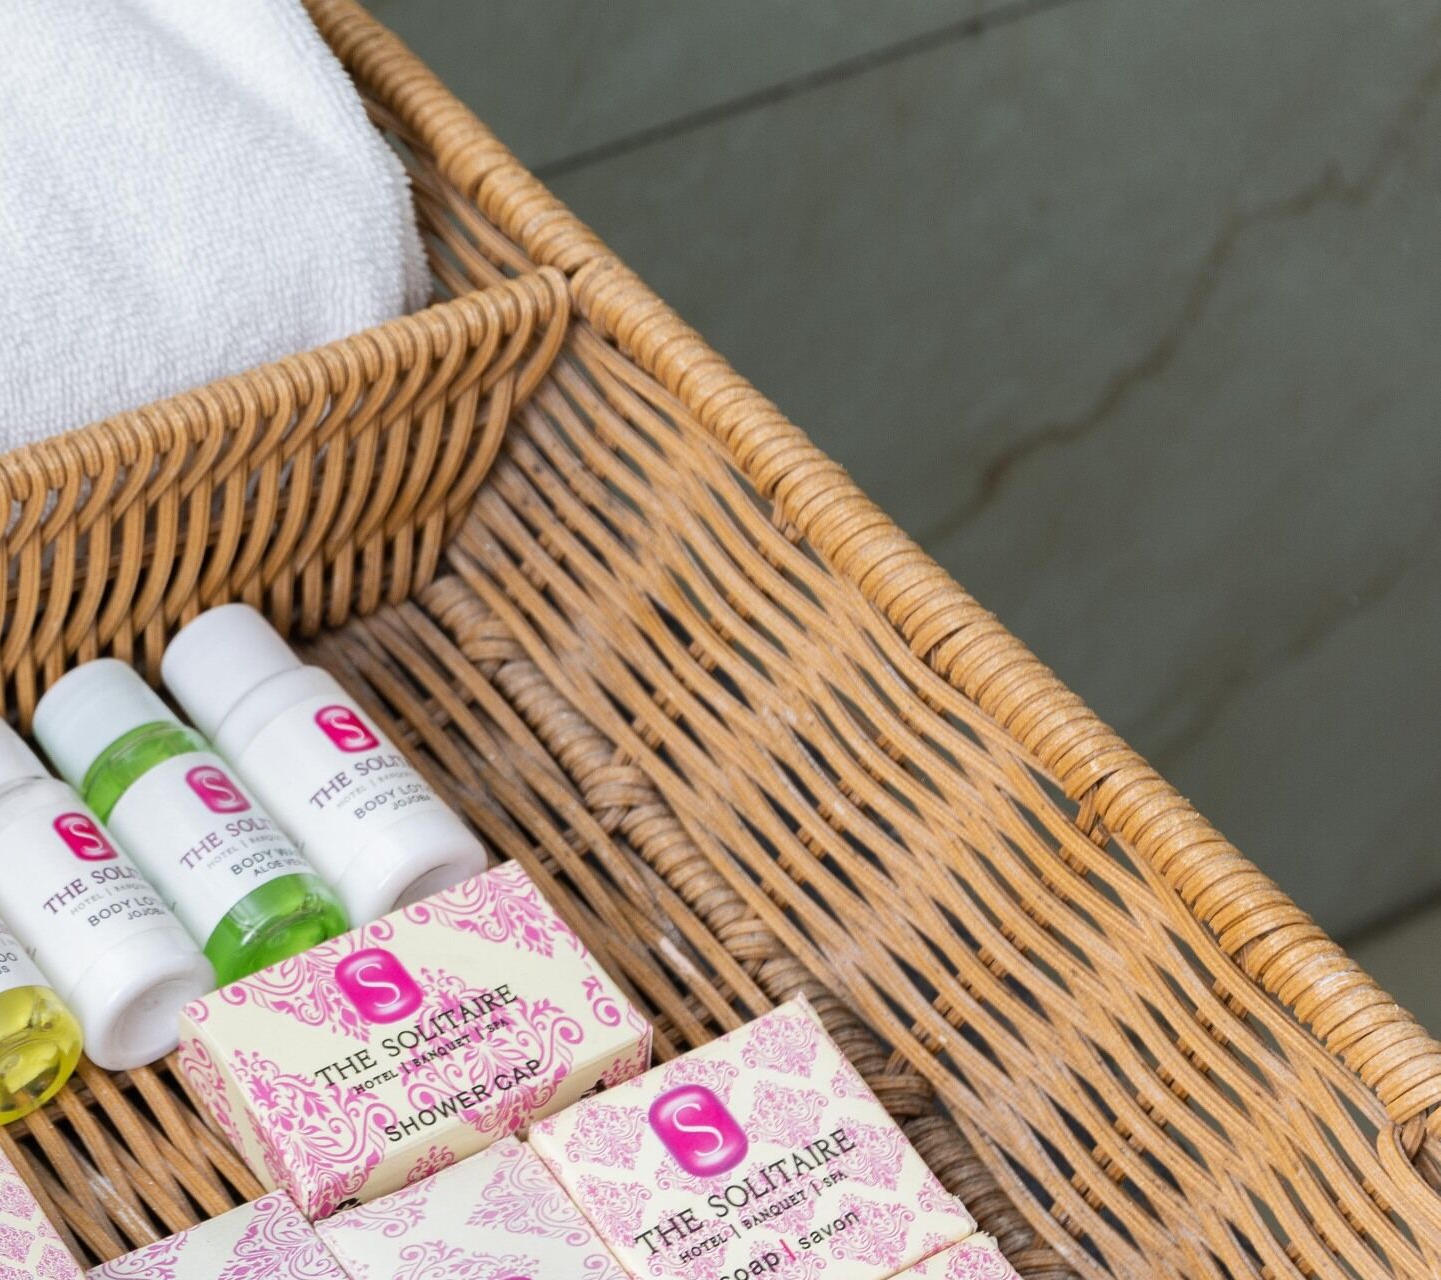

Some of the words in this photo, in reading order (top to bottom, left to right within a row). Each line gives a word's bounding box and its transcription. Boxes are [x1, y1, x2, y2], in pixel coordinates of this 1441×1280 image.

[309, 772, 353, 810] THE
[354, 789, 397, 820] BODY
[180, 832, 224, 870] THE
[231, 849, 273, 876] BODY
[254, 860, 284, 877] ALOE
[43, 878, 88, 915] THE
[87, 896, 132, 927] BODY
[314, 1049, 378, 1087] THE
[381, 983, 519, 1057] SOLITAIRE
[353, 1070, 400, 1095] HOTEL
[412, 1034, 472, 1068] BANQUET
[488, 1018, 510, 1034] SPA
[384, 1084, 492, 1143] SHOWER
[494, 1059, 542, 1091] CAP
[635, 1208, 704, 1255] THE
[708, 1128, 856, 1218] SOLITAIRE
[678, 1234, 729, 1264] HOTEL
[741, 1190, 808, 1230] BANQUET
[822, 1170, 848, 1188] SPA
[798, 1211, 859, 1250] savon
